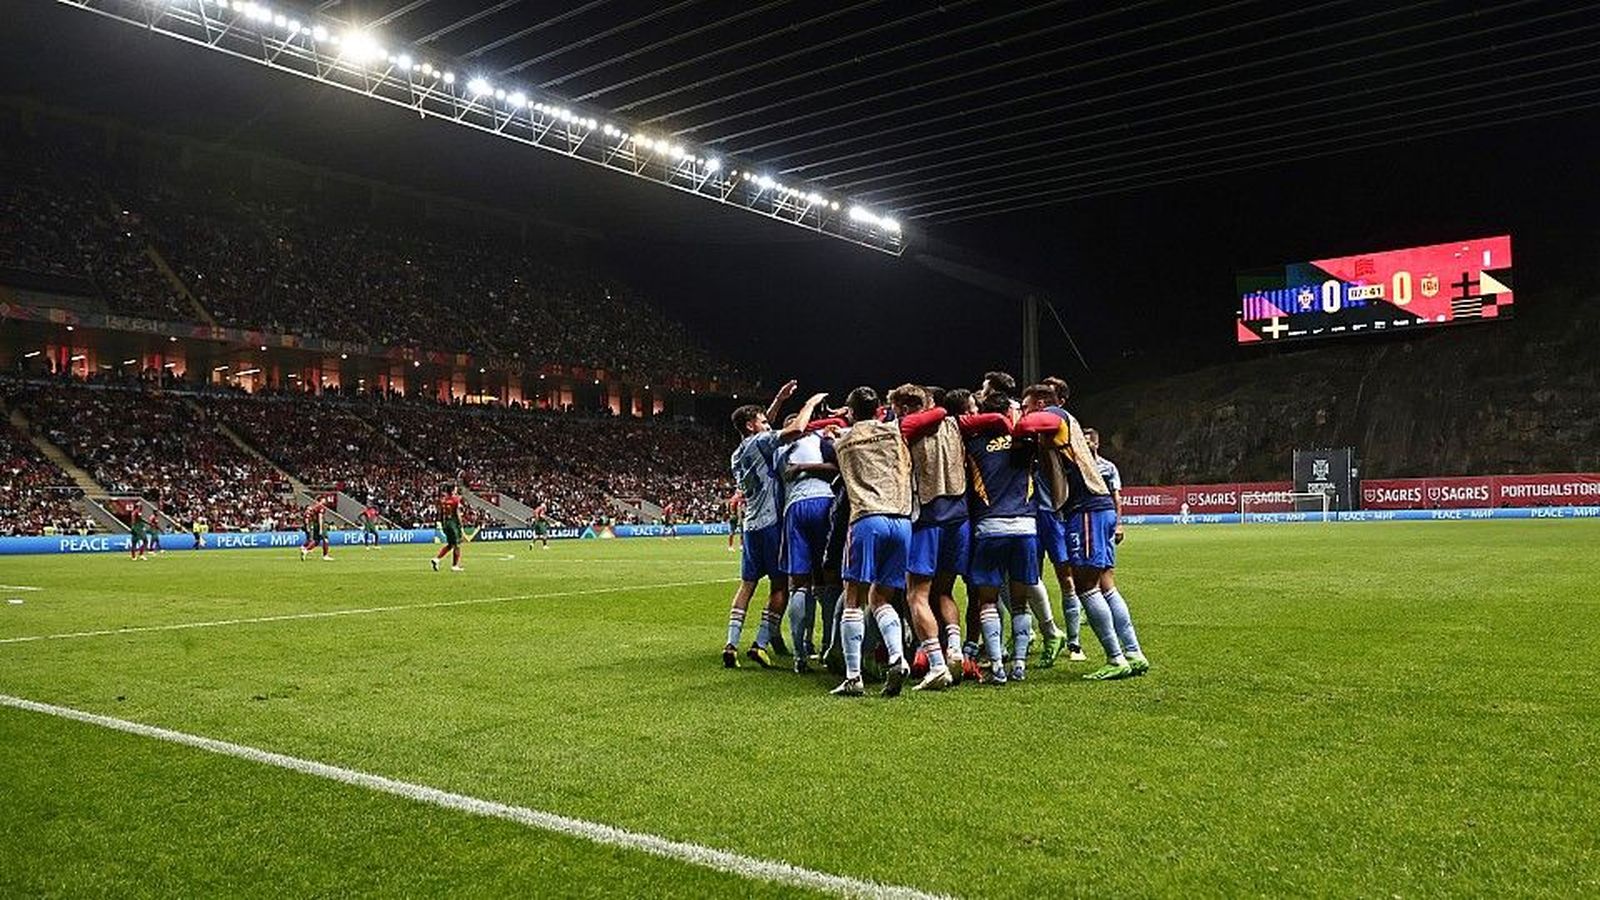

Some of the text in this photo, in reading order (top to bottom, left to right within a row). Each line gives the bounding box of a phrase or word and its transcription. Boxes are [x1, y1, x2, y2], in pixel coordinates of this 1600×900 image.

[1393, 271, 1412, 305] 0
[1322, 280, 1341, 314] 0
[1198, 491, 1237, 505] SAGRES
[1376, 488, 1422, 502] SAGRES
[1441, 486, 1489, 501] SAGRES
[1531, 507, 1563, 518] PEACE
[217, 535, 258, 547] PEACE
[270, 533, 299, 546] МИР
[480, 531, 504, 540] UEFA
[547, 528, 579, 538] LEAGUE
[60, 537, 110, 551] PEACE
